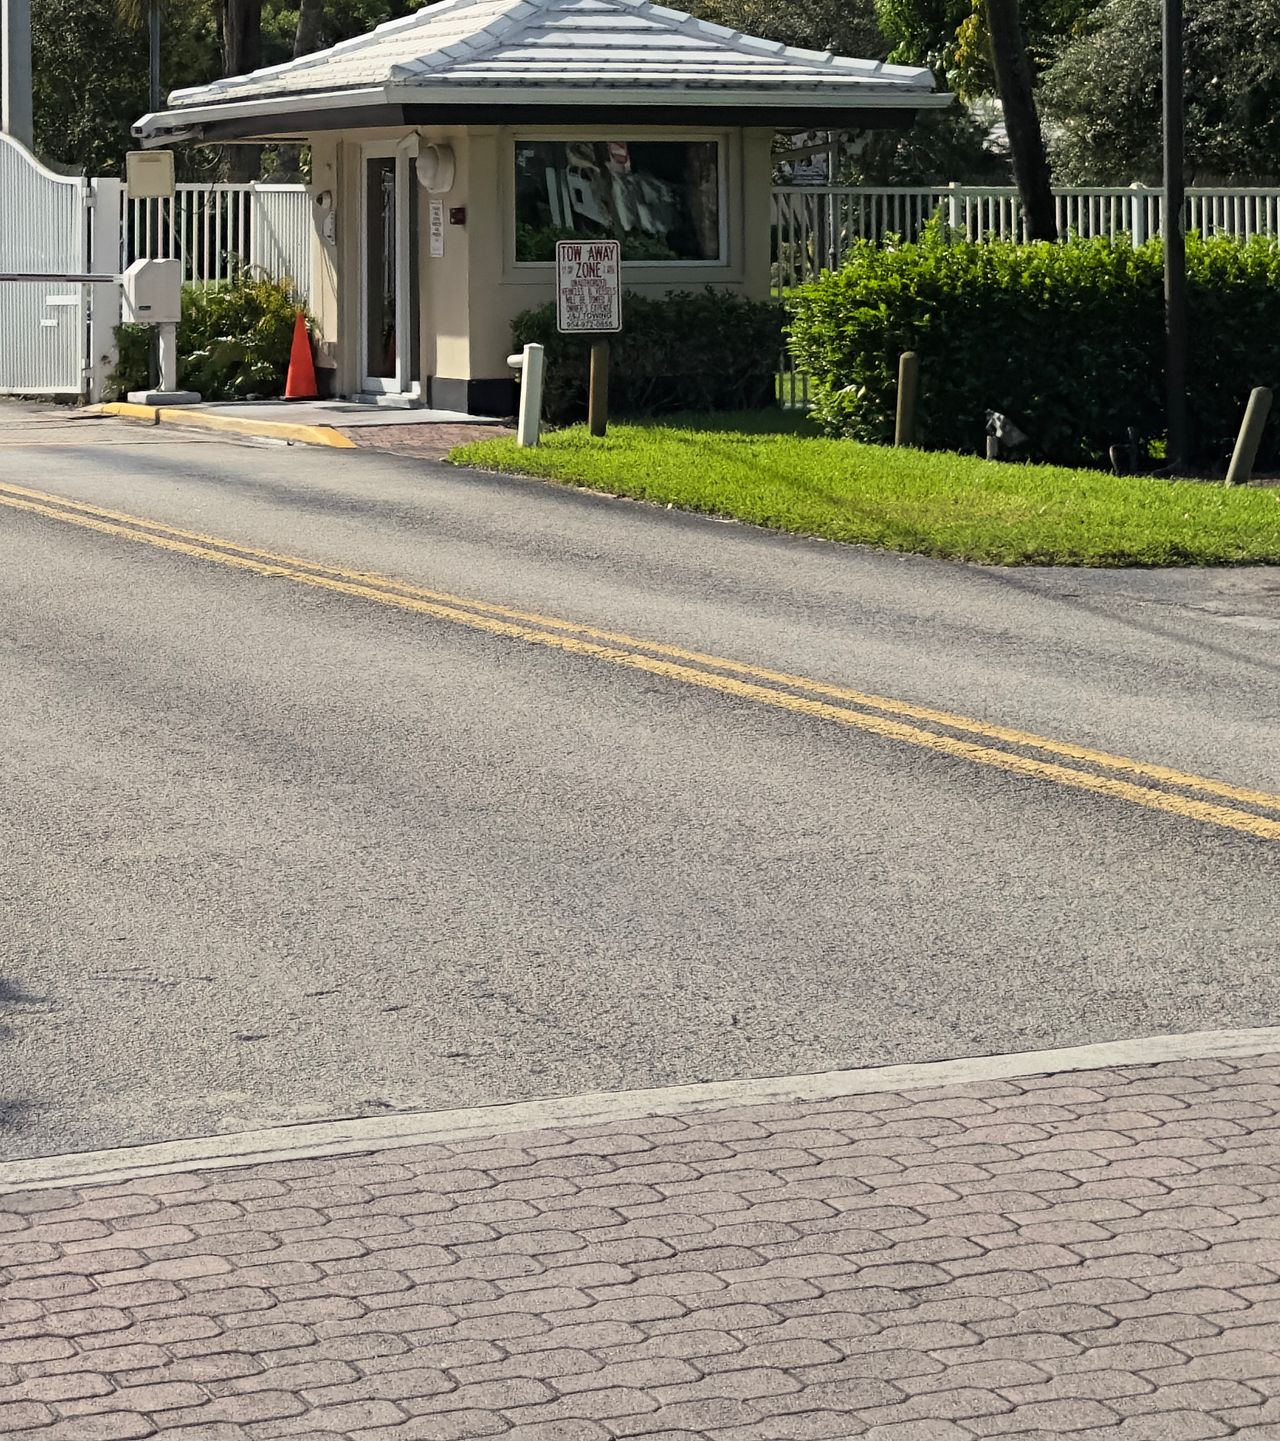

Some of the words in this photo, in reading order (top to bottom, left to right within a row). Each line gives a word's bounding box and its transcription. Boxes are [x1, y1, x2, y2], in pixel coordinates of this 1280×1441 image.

[561, 245, 582, 262] TOW
[588, 245, 616, 262] AWAY
[576, 262, 602, 279] ZONE
